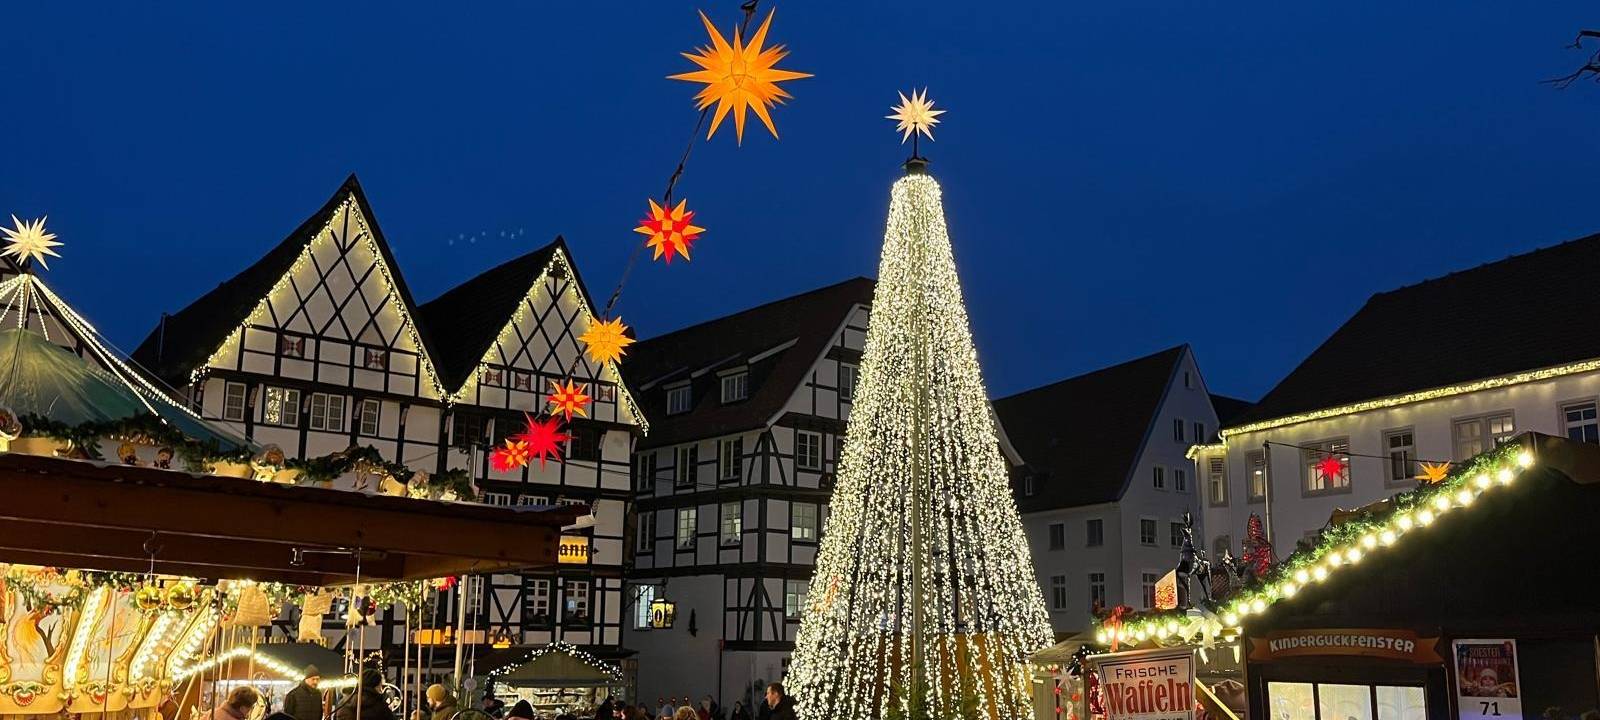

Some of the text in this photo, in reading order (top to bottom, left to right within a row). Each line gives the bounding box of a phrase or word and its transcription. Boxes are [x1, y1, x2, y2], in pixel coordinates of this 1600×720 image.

[1269, 634, 1415, 654] KINDERGUCKFENSTER
[1115, 664, 1178, 680] FRISCHE
[1105, 678, 1192, 715] Waffeln
[1479, 701, 1502, 717] 71
